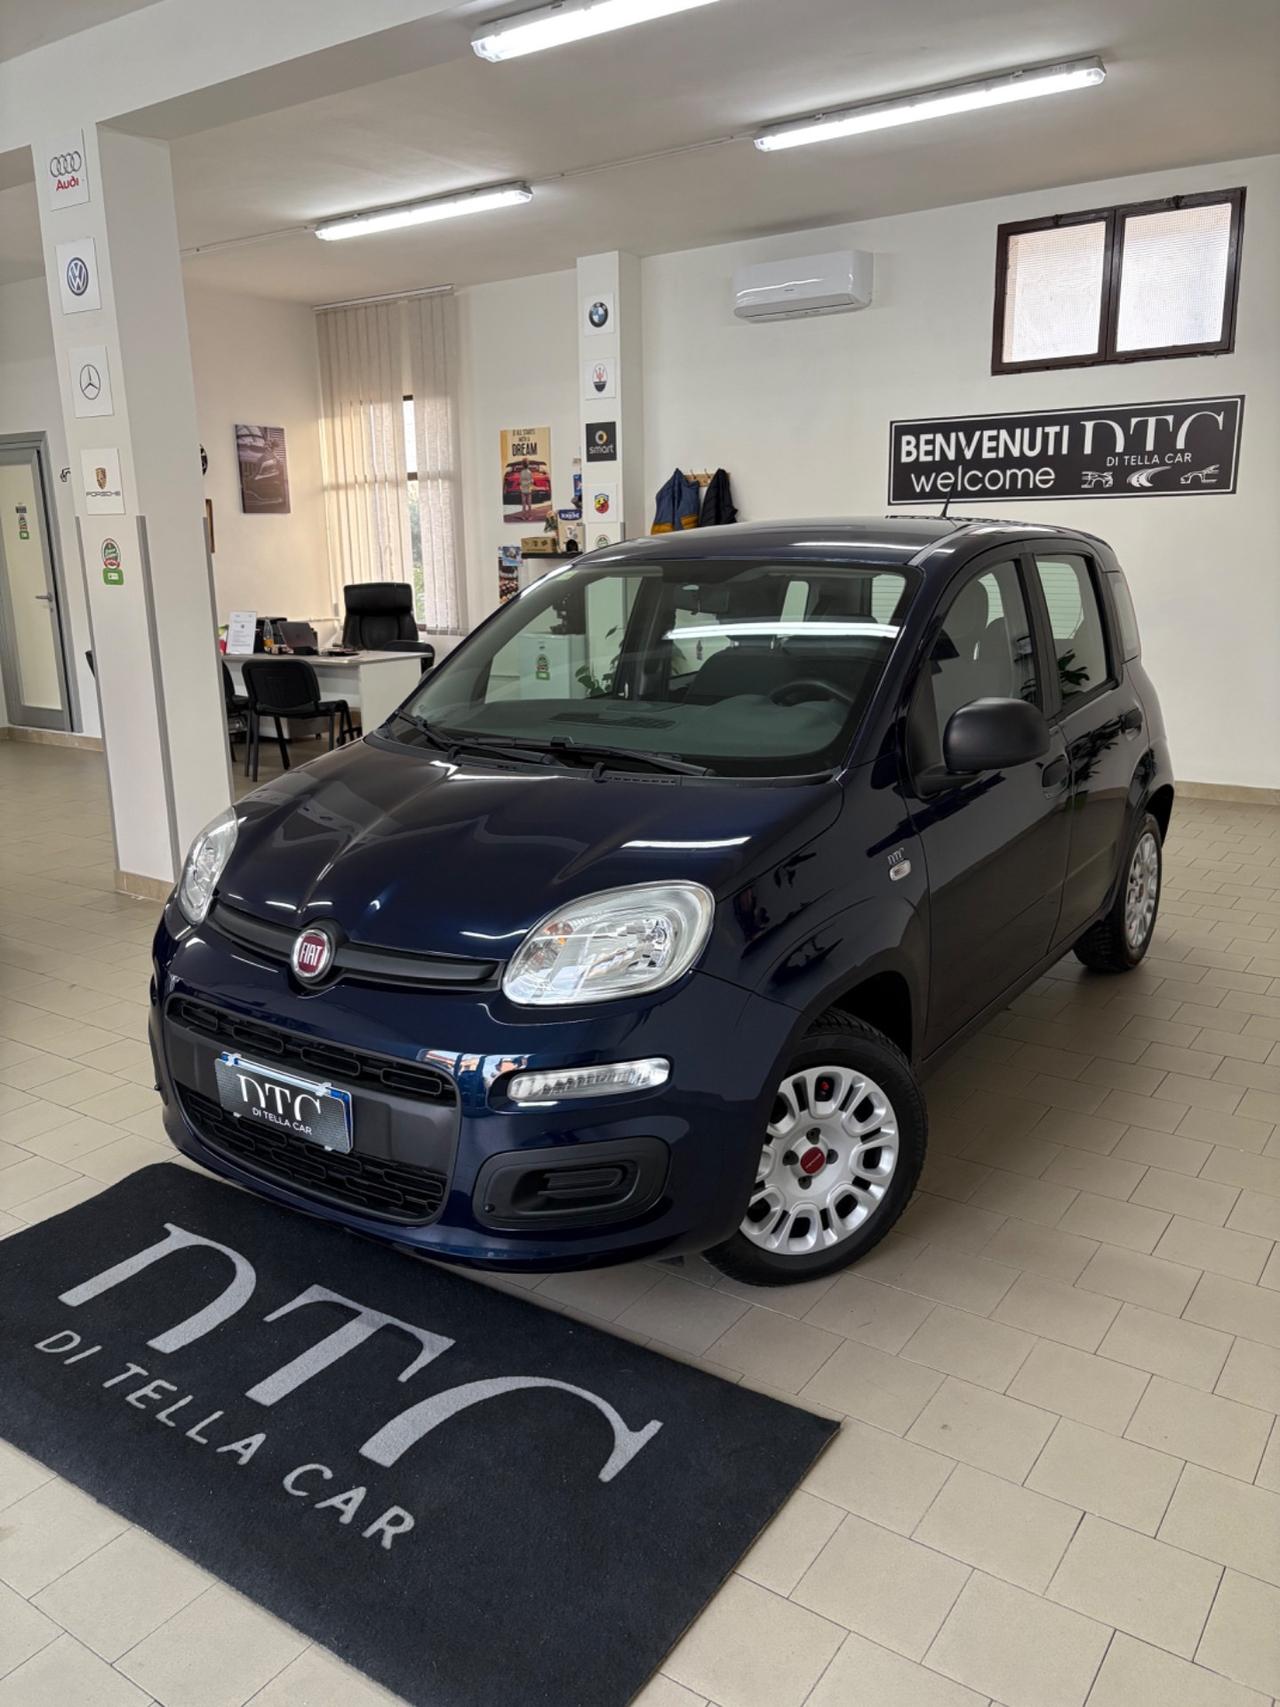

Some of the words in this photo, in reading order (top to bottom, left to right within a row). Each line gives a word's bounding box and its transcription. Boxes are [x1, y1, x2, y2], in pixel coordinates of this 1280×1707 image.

[56, 176, 79, 191] Audi
[512, 442, 537, 456] DREAM
[589, 444, 614, 454] smart
[901, 425, 1069, 463] BENVENUTI
[1106, 457, 1119, 467] DI
[1123, 454, 1160, 466] TELLA
[1166, 453, 1192, 464] CAR
[911, 466, 1055, 493] welcome
[299, 942, 323, 966] FIAT
[252, 1107, 261, 1116] DI
[263, 1111, 291, 1127] TELLA
[293, 1121, 312, 1135] CAR
[35, 1329, 91, 1364] DI
[102, 1362, 267, 1466] TELLA
[282, 1462, 416, 1550] CAR
